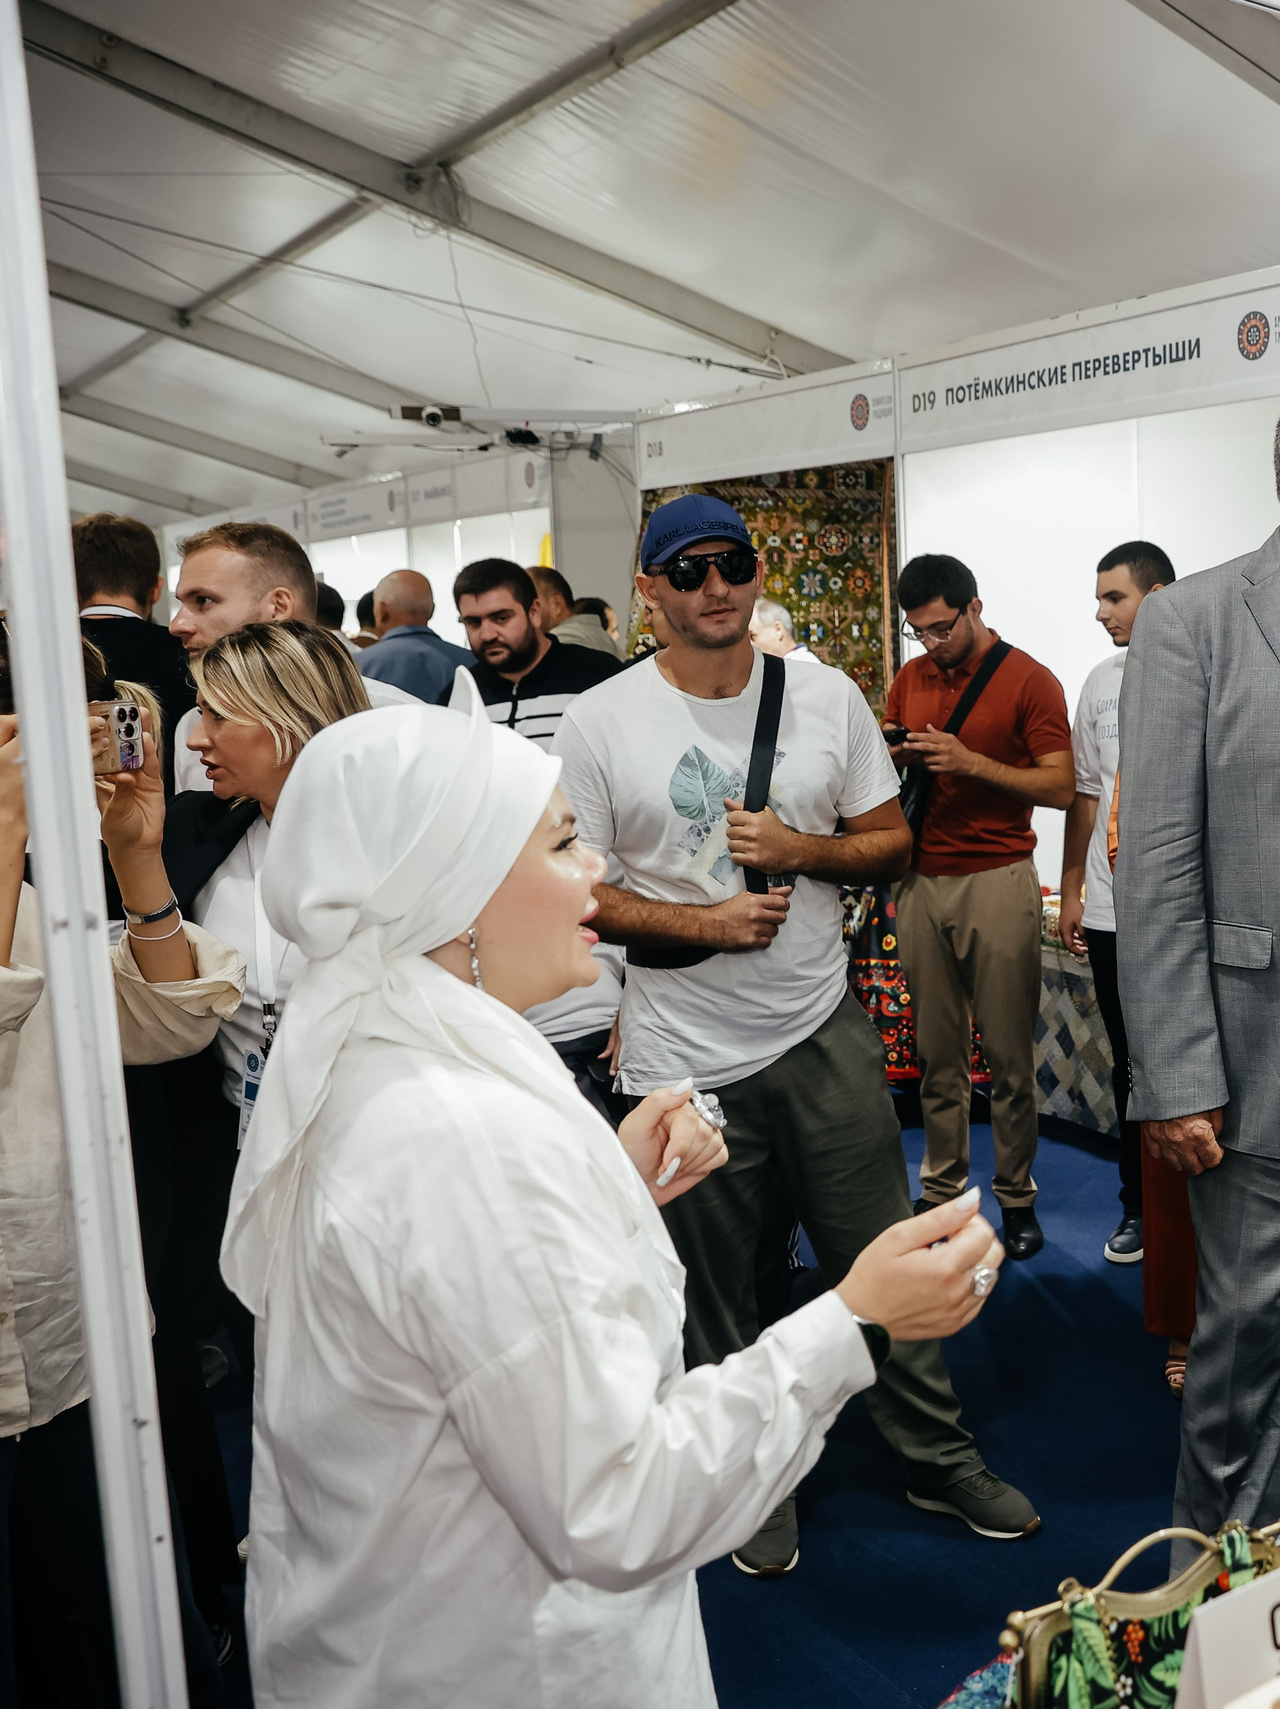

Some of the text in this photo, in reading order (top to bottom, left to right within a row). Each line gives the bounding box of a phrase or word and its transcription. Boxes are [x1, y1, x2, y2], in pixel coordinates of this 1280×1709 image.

[912, 337, 1201, 413] D19 ПОТЁМКИНСКИЕ ПЕРЕВЕРТЫШИ
[655, 527, 684, 550] KARL
